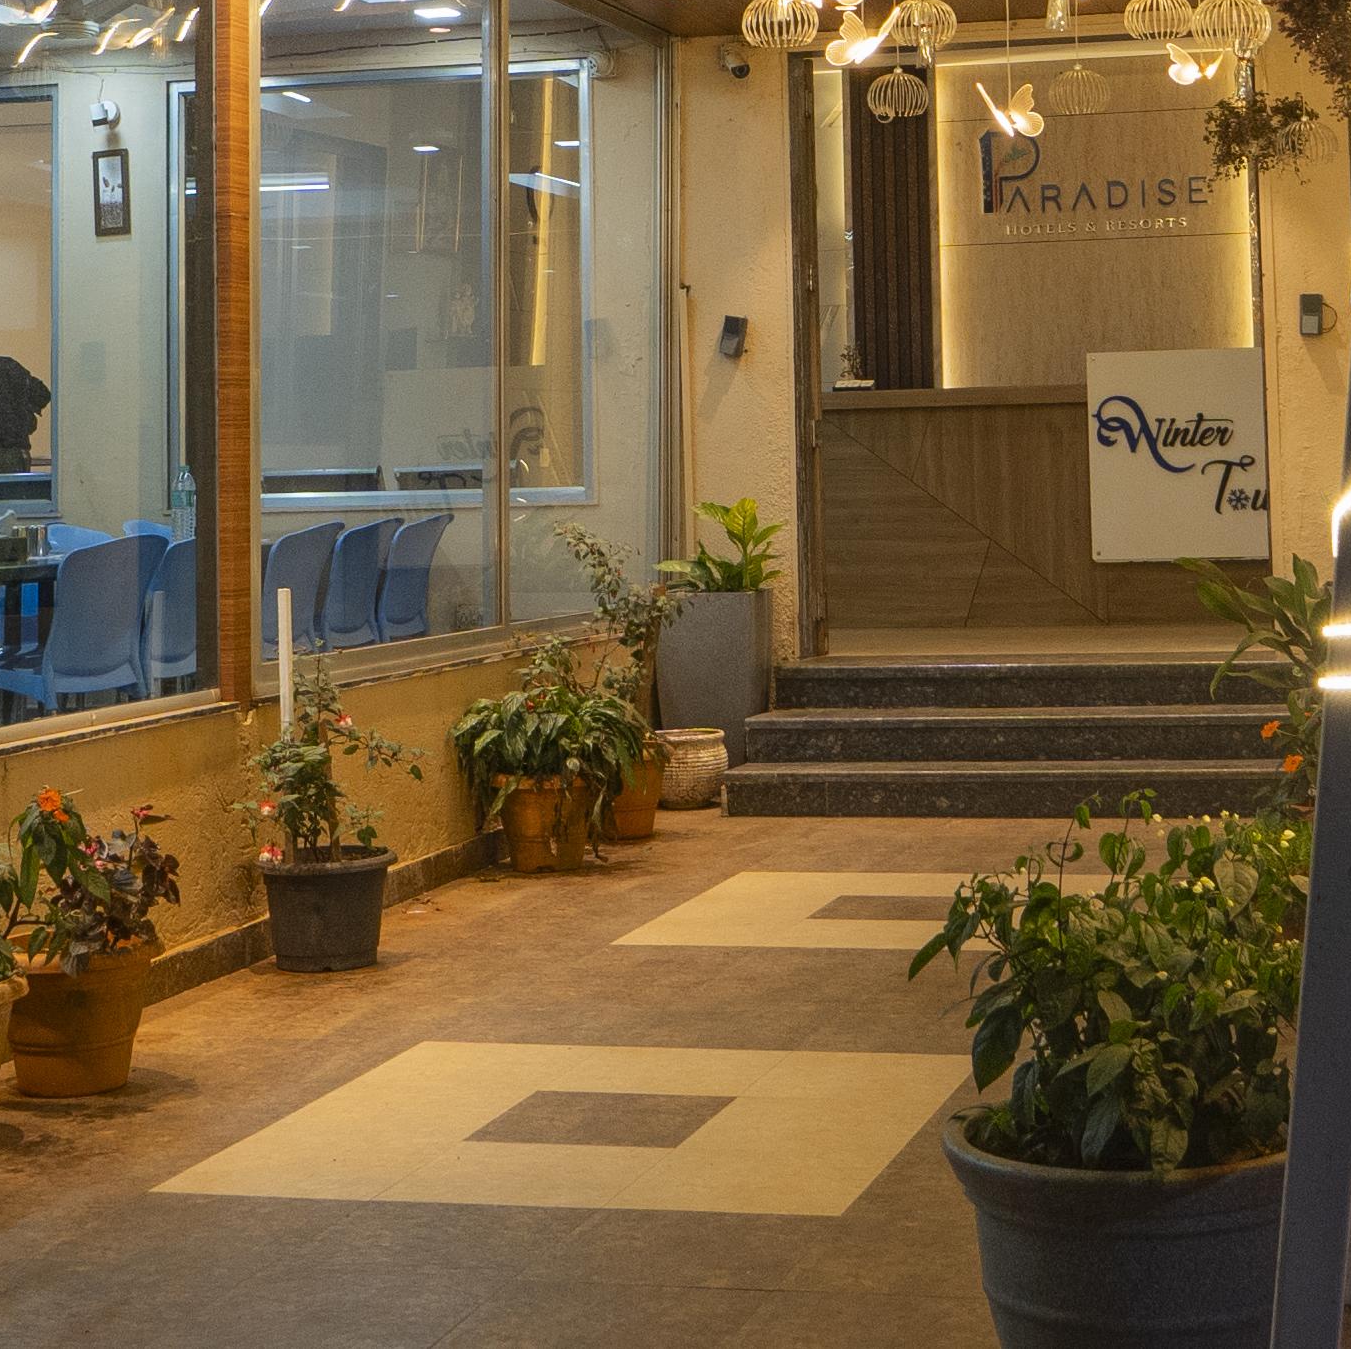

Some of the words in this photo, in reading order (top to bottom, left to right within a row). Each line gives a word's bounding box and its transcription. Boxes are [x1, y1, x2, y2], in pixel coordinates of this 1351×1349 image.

[979, 130, 1209, 214] PARADISE
[1006, 222, 1077, 236] HOTELS
[1085, 222, 1097, 233] &
[1106, 217, 1188, 232] RESORTS
[1092, 395, 1234, 473] Winter
